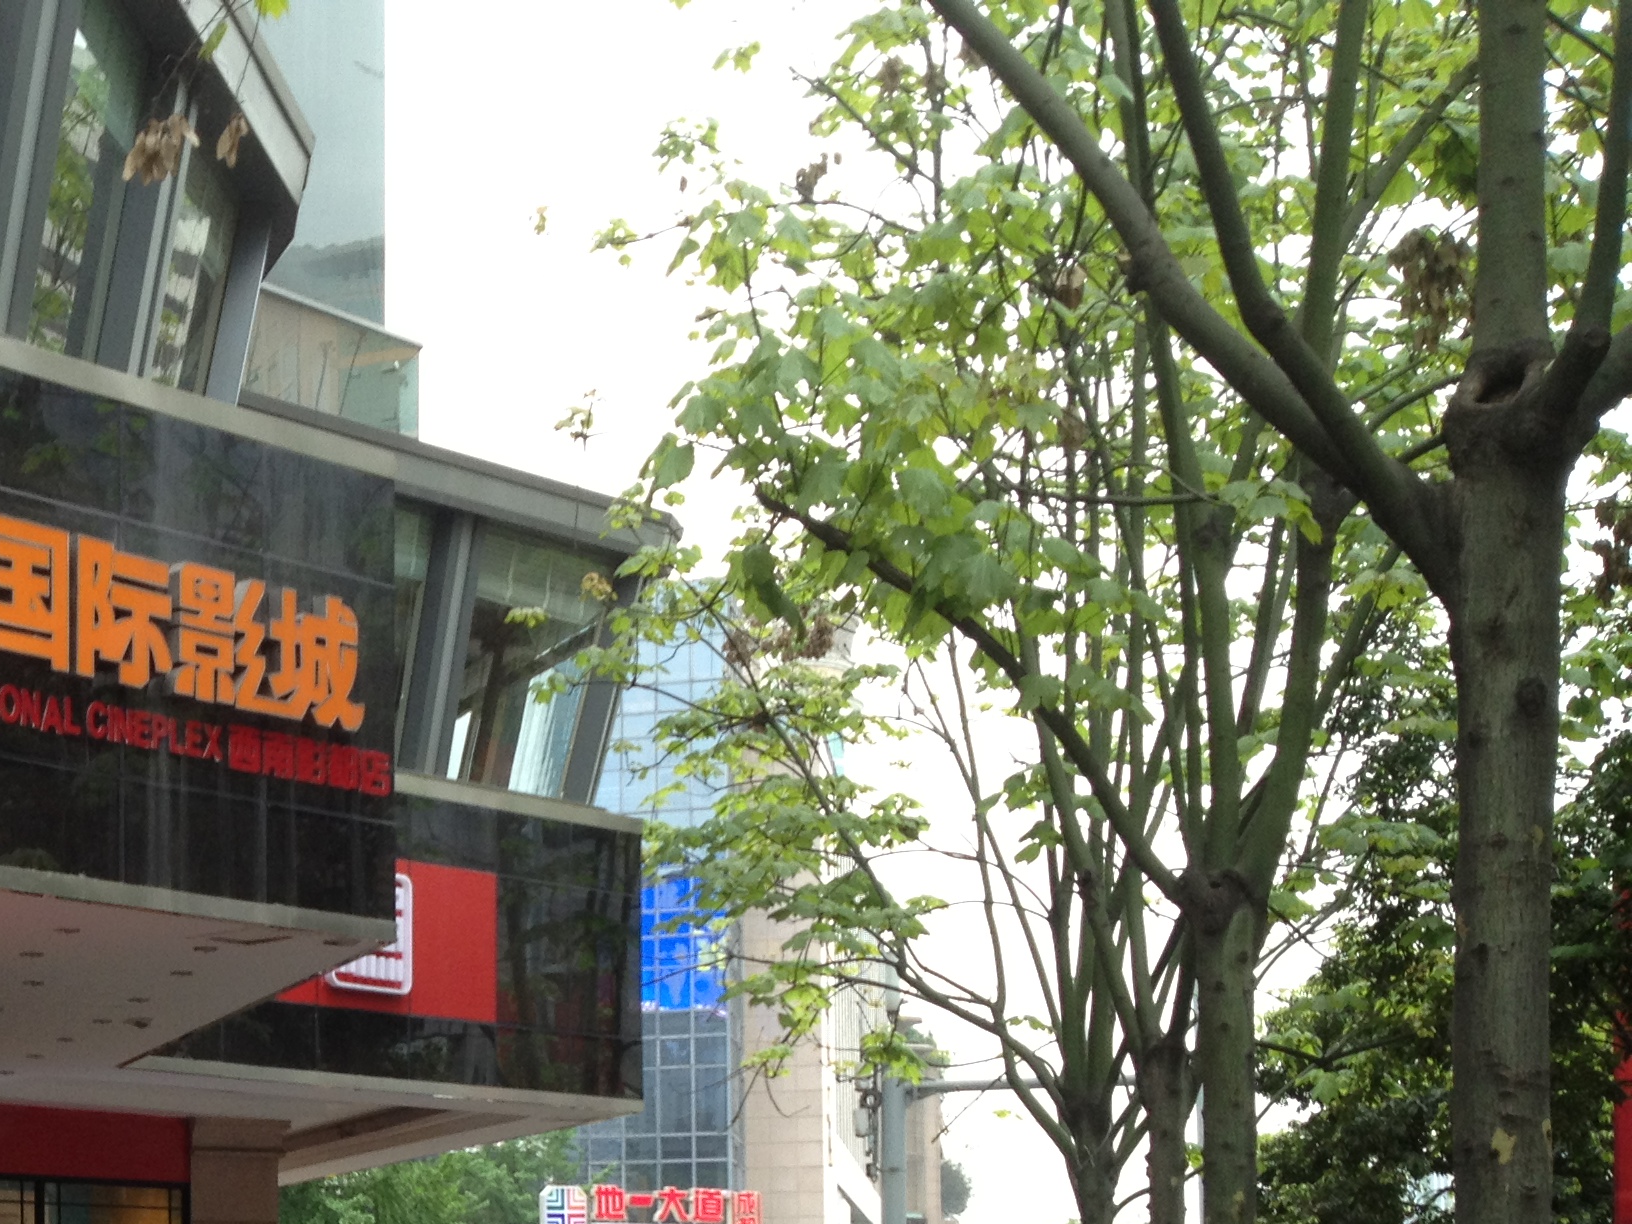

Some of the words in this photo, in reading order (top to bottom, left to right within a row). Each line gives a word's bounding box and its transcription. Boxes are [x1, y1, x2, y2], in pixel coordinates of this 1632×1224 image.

[85, 700, 223, 763] CINEPLEX
[594, 1184, 724, 1223] 地一大道
